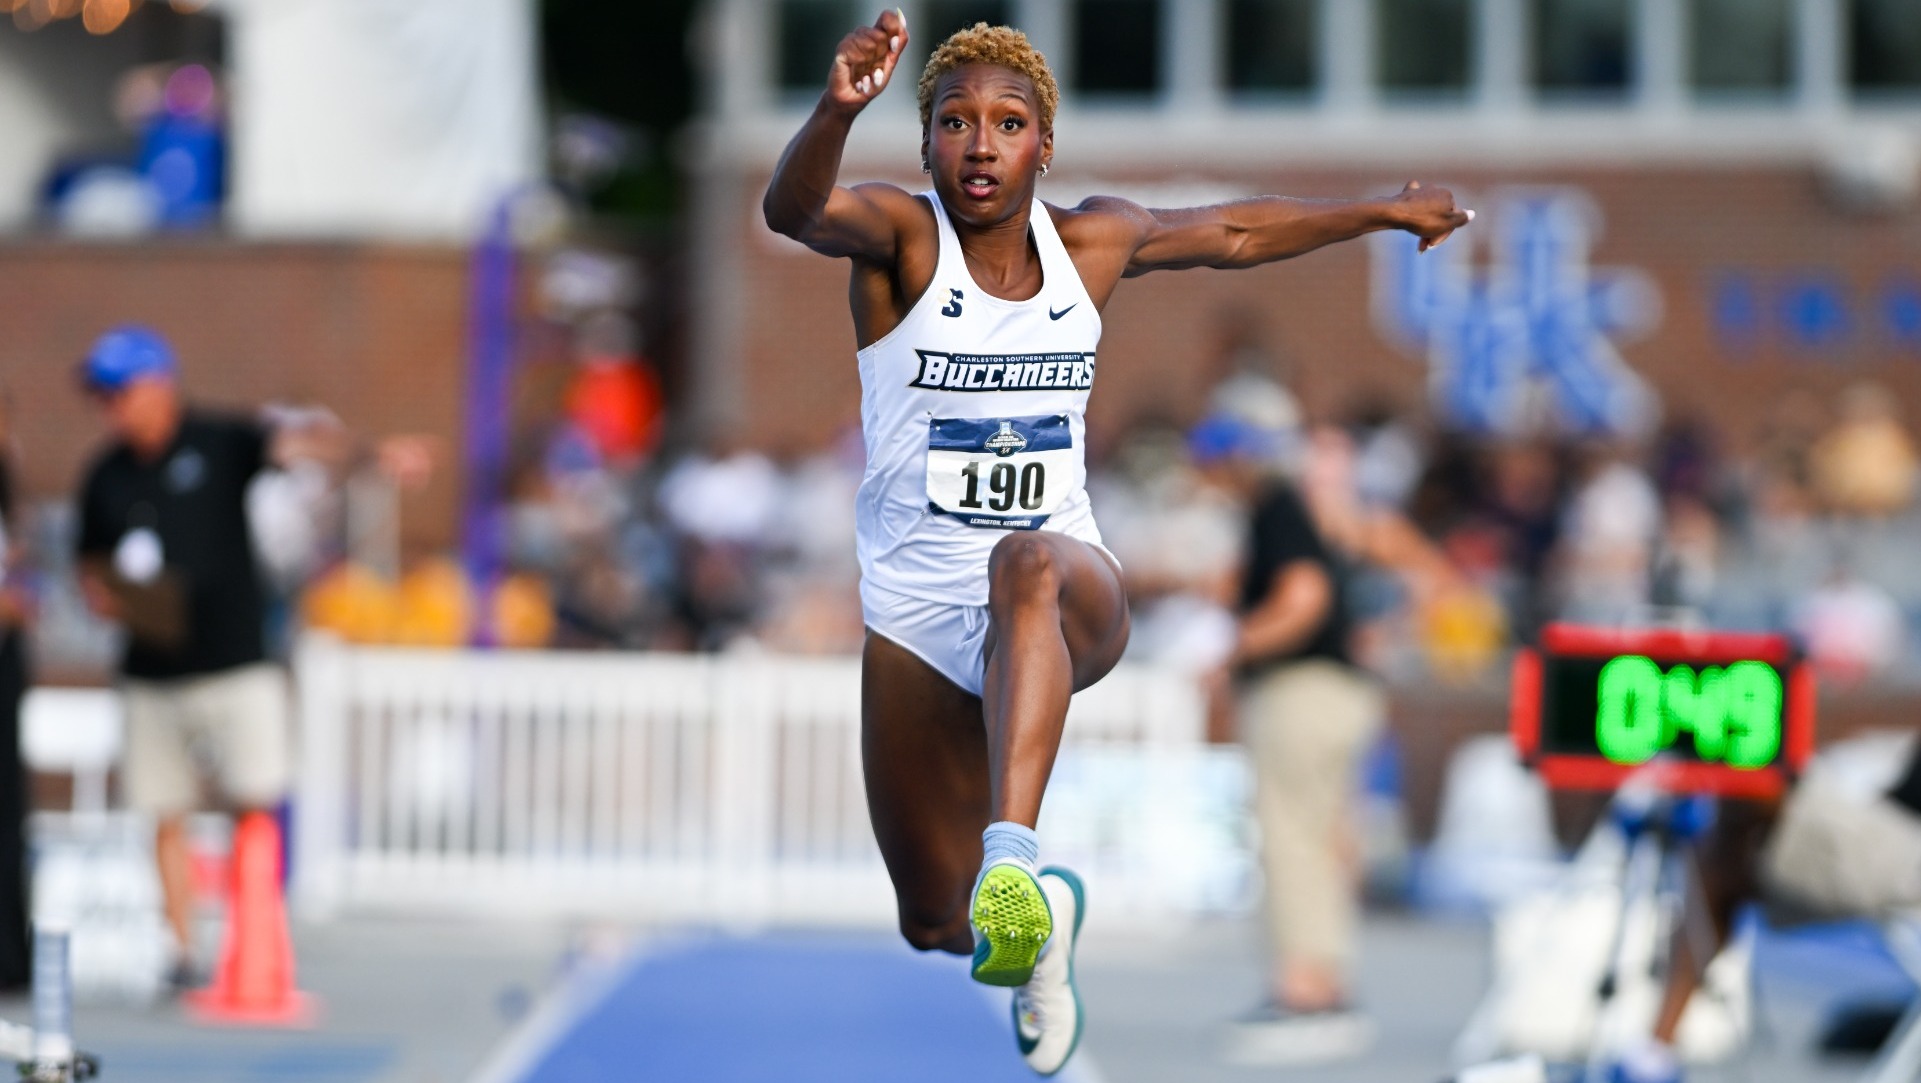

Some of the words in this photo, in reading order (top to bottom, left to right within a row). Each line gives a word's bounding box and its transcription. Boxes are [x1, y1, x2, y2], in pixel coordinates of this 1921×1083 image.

[918, 353, 1095, 389] BUCCANEERS
[955, 355, 1004, 363] CHARLESTON
[959, 461, 1045, 511] 190
